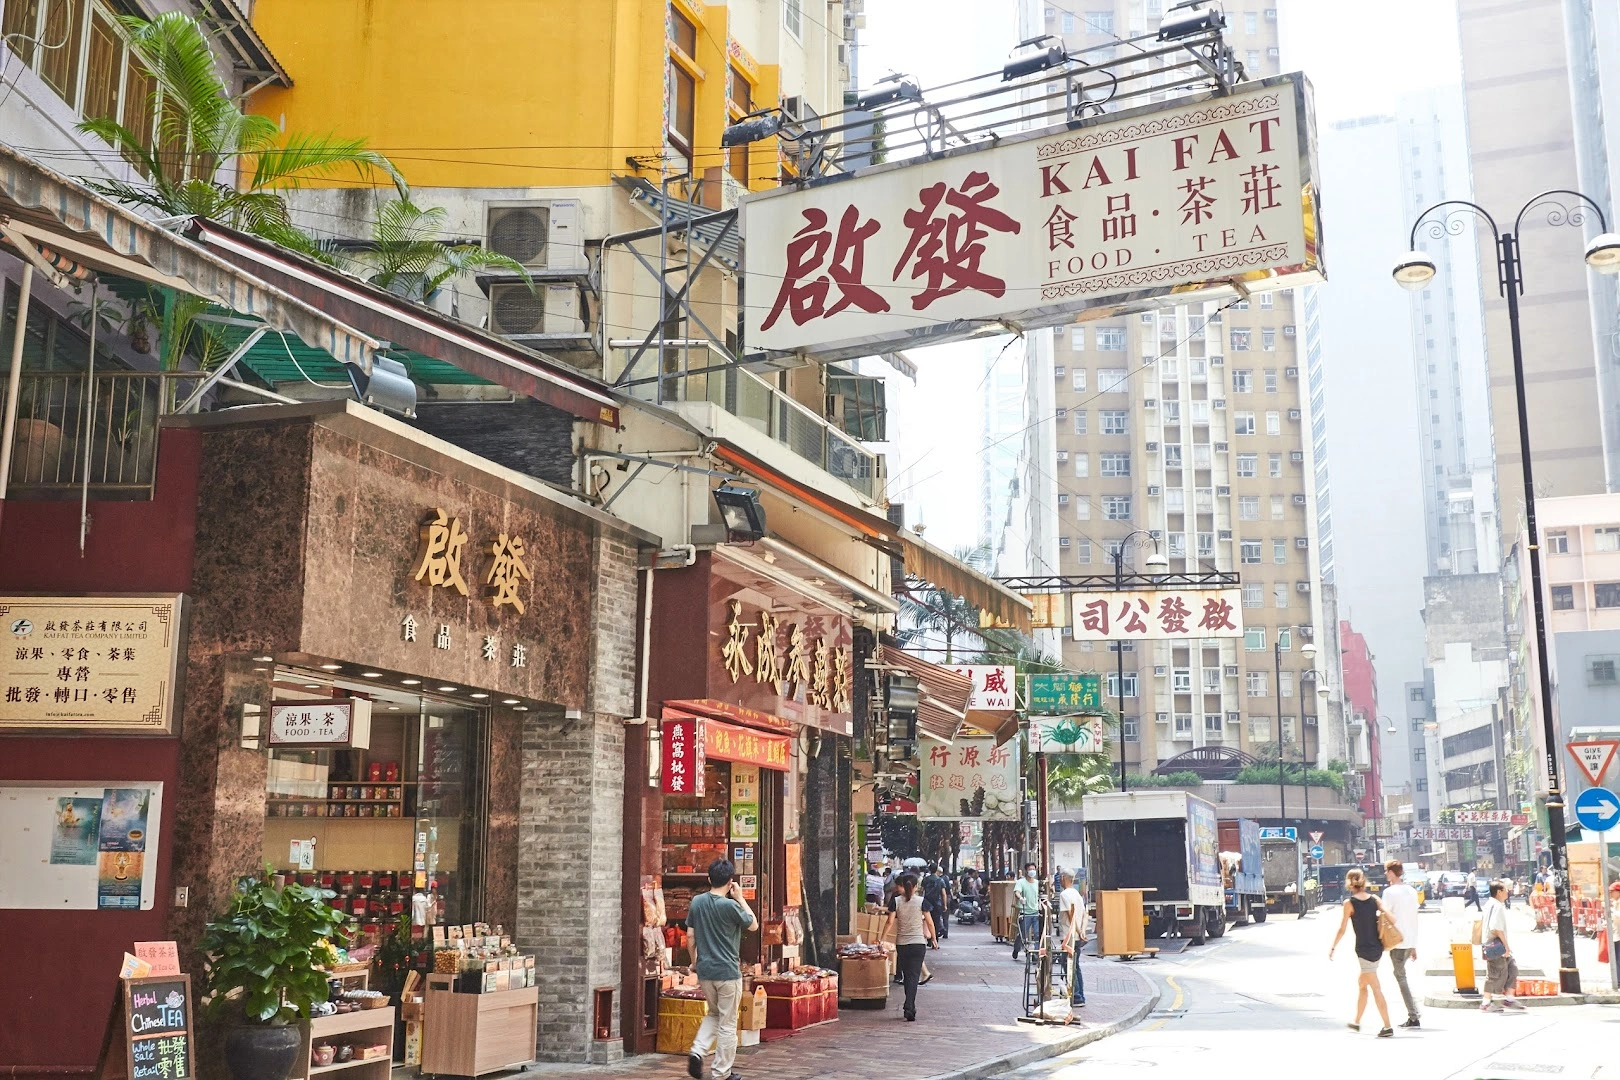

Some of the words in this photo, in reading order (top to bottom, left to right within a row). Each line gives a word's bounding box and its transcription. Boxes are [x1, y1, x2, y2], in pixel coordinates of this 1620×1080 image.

[1039, 147, 1141, 198] KAI
[1171, 117, 1281, 172] FAT
[1047, 247, 1134, 279] FOOD
[1192, 223, 1268, 253] TEA
[56, 666, 91, 682] 專營
[986, 698, 1010, 707] WAI
[285, 728, 310, 737] FOOD
[319, 728, 334, 737] TEA
[670, 724, 686, 792] 燕窩批發
[133, 991, 157, 1008] Herbal
[131, 1013, 164, 1032] Chinese
[157, 1004, 184, 1027] TEA
[132, 1040, 156, 1053] Whole
[158, 1036, 186, 1055] 批發
[134, 1051, 155, 1062] sale
[133, 1063, 158, 1078] Retail
[158, 1054, 186, 1079] 零售
